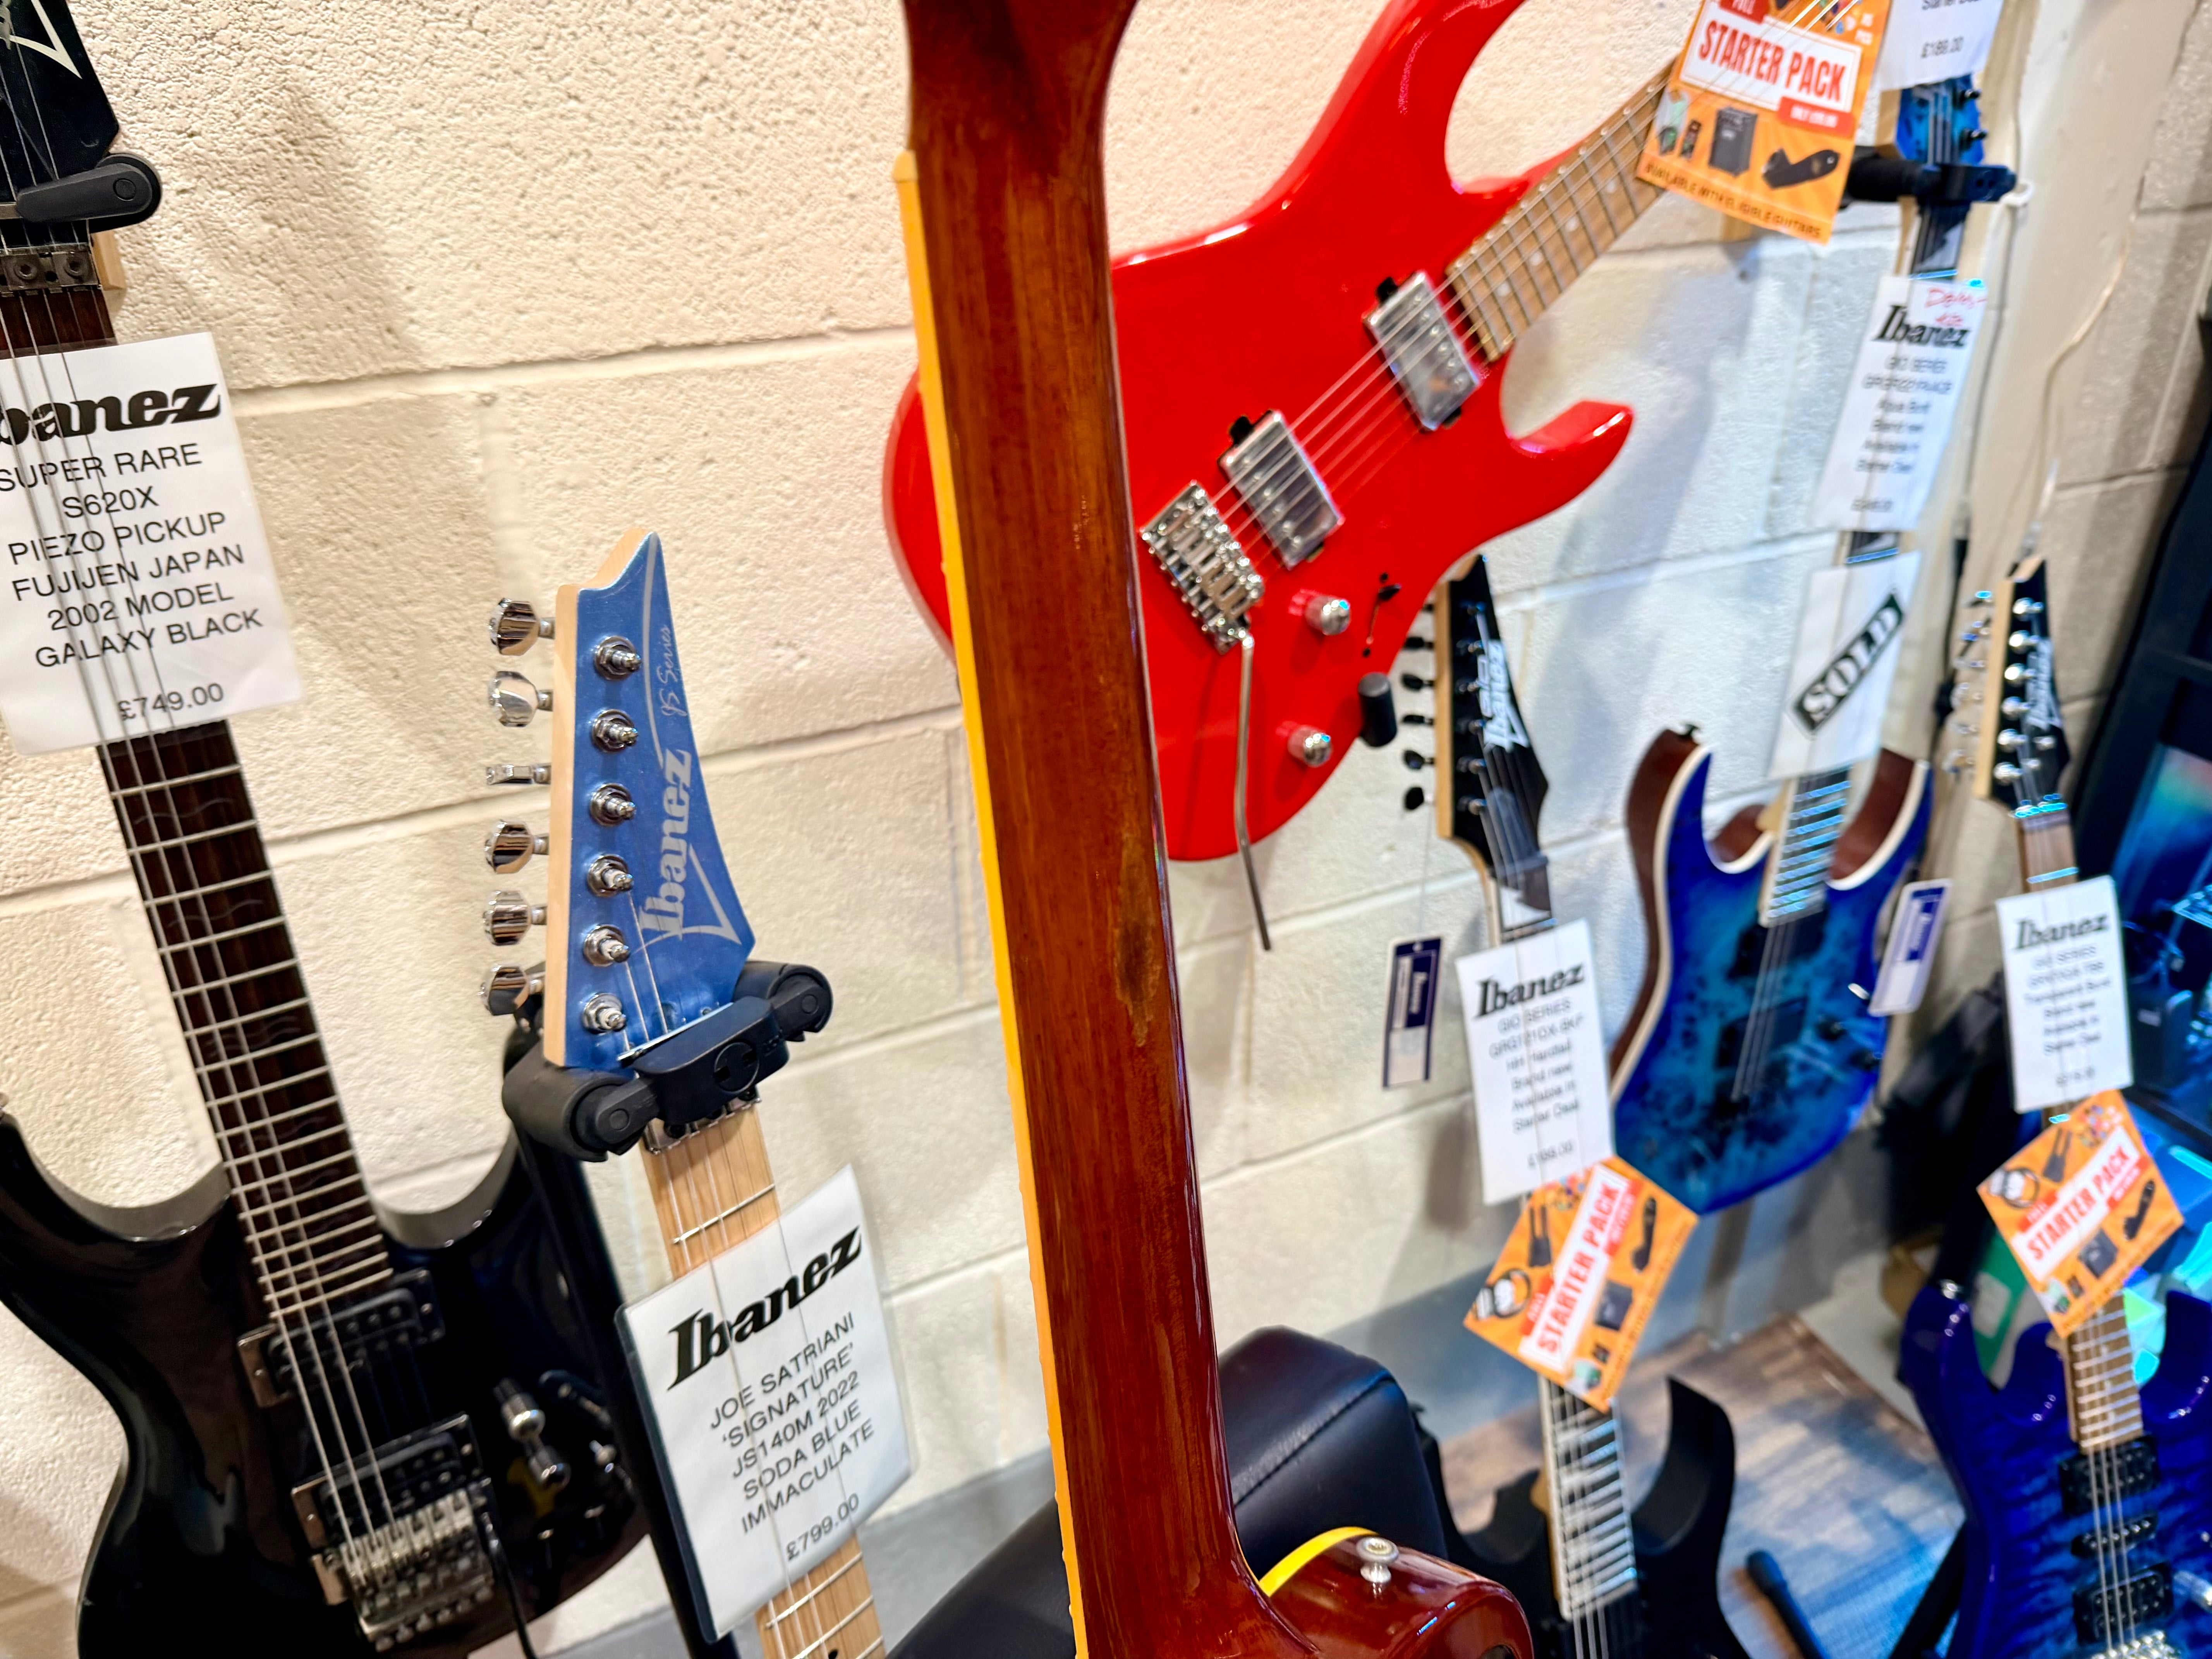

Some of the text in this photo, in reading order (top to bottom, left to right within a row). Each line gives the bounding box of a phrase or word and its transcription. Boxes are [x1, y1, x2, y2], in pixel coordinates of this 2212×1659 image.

[1699, 19, 1846, 102] STARTER PACK
[1870, 304, 1972, 348] Ibanez
[0, 443, 203, 491] SUPER RARE
[63, 486, 160, 518] S620X
[8, 512, 226, 565] PIEZO PICKUP
[12, 544, 245, 601] FUJIJEN JAPAN
[35, 608, 264, 668] GALAXY BLACK
[48, 582, 234, 631] 2002 MODEL
[657, 624, 678, 684] Series
[1802, 605, 1900, 721] SOLD
[117, 682, 225, 721] £749.00
[1482, 638, 1514, 753] Ibanez
[637, 747, 692, 943] Ibanez
[2012, 912, 2111, 953] Ibanez
[1471, 961, 1585, 1019] Ibanez
[1523, 995, 1571, 1022] SERIES
[2027, 1187, 2098, 1261] STARTER
[2092, 1144, 2130, 1194] PACK
[1537, 1182, 1621, 1354] STARTER PACK
[666, 1224, 863, 1391] Ibanez
[711, 1311, 855, 1430] JOE SATRIANI
[733, 1370, 860, 1479] JS140M 2022
[744, 1398, 862, 1500] SODA BLUE
[741, 1417, 875, 1534] IMMACULATE
[786, 1493, 860, 1561] £799.00
